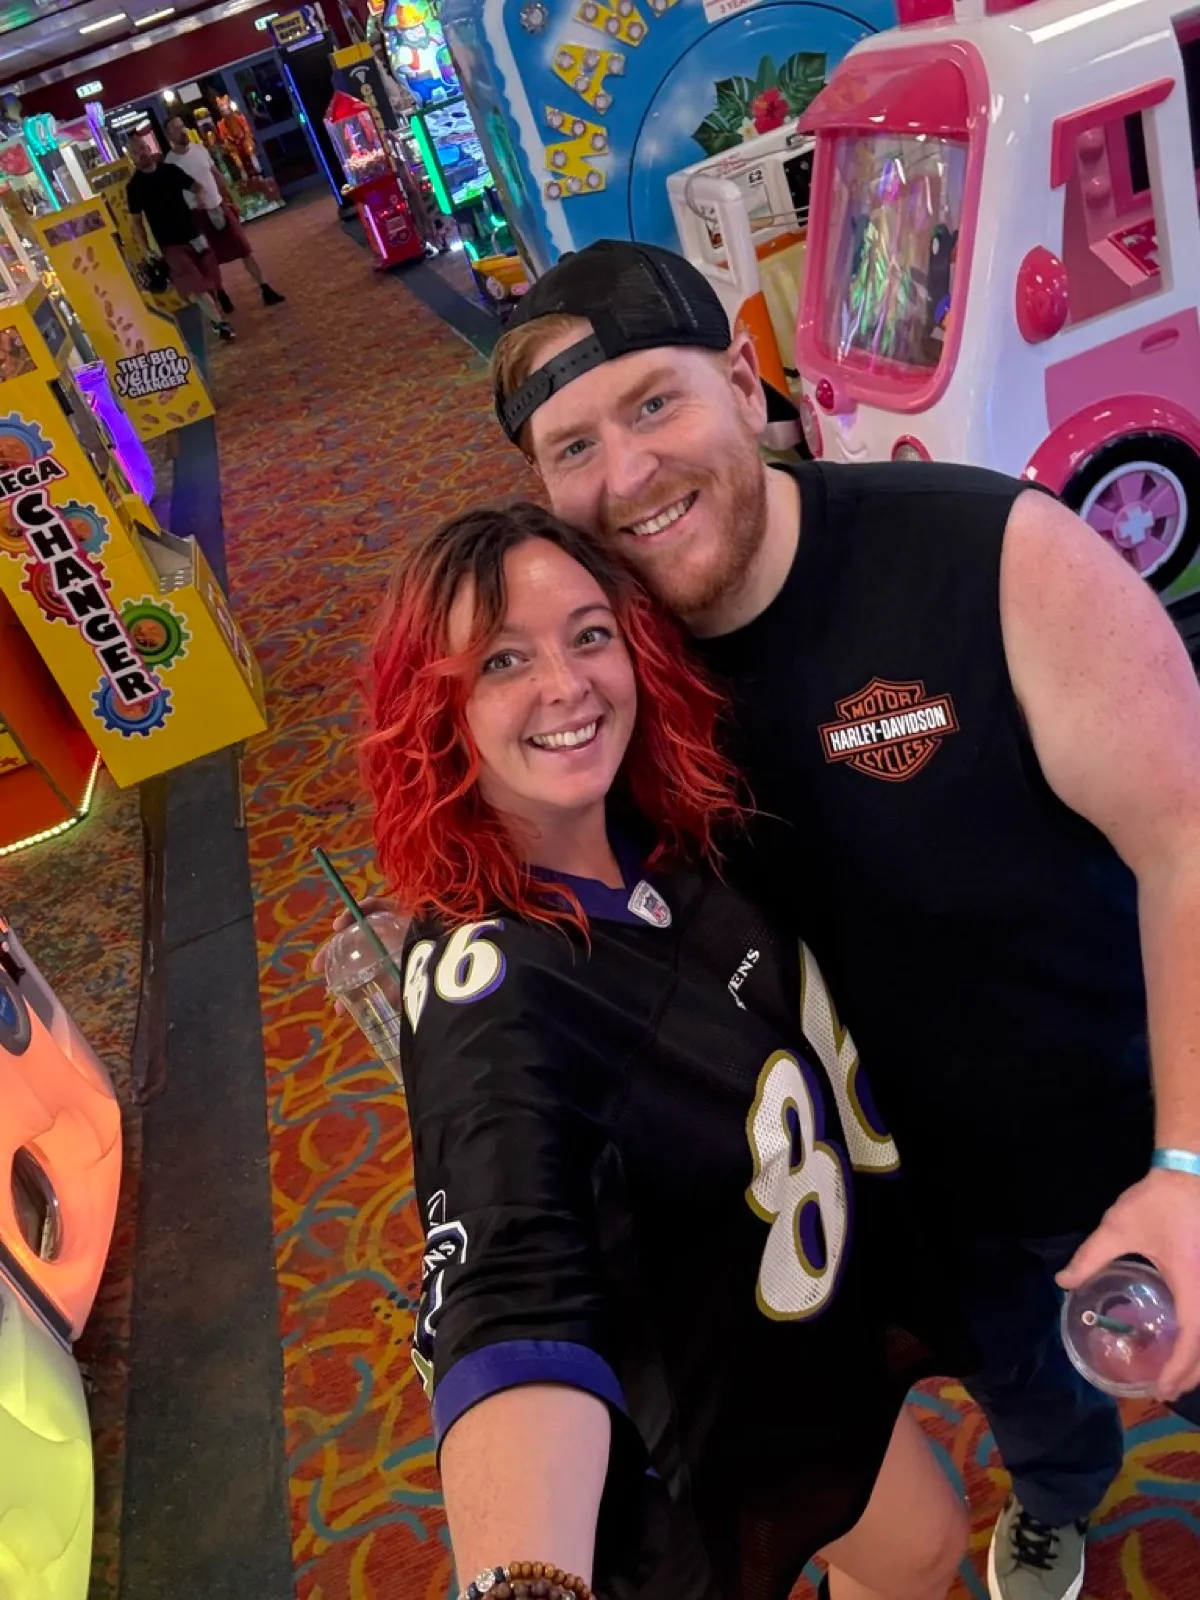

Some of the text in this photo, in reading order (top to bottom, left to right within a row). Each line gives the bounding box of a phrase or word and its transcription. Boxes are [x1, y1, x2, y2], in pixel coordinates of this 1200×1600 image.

[118, 348, 177, 373] THE BIG
[0, 457, 66, 498] EGA
[16, 492, 155, 701] CHANGER
[851, 688, 912, 717] MOTOR
[829, 706, 947, 752] HARLEY-DAVIDSON
[862, 740, 924, 773] CYCLES
